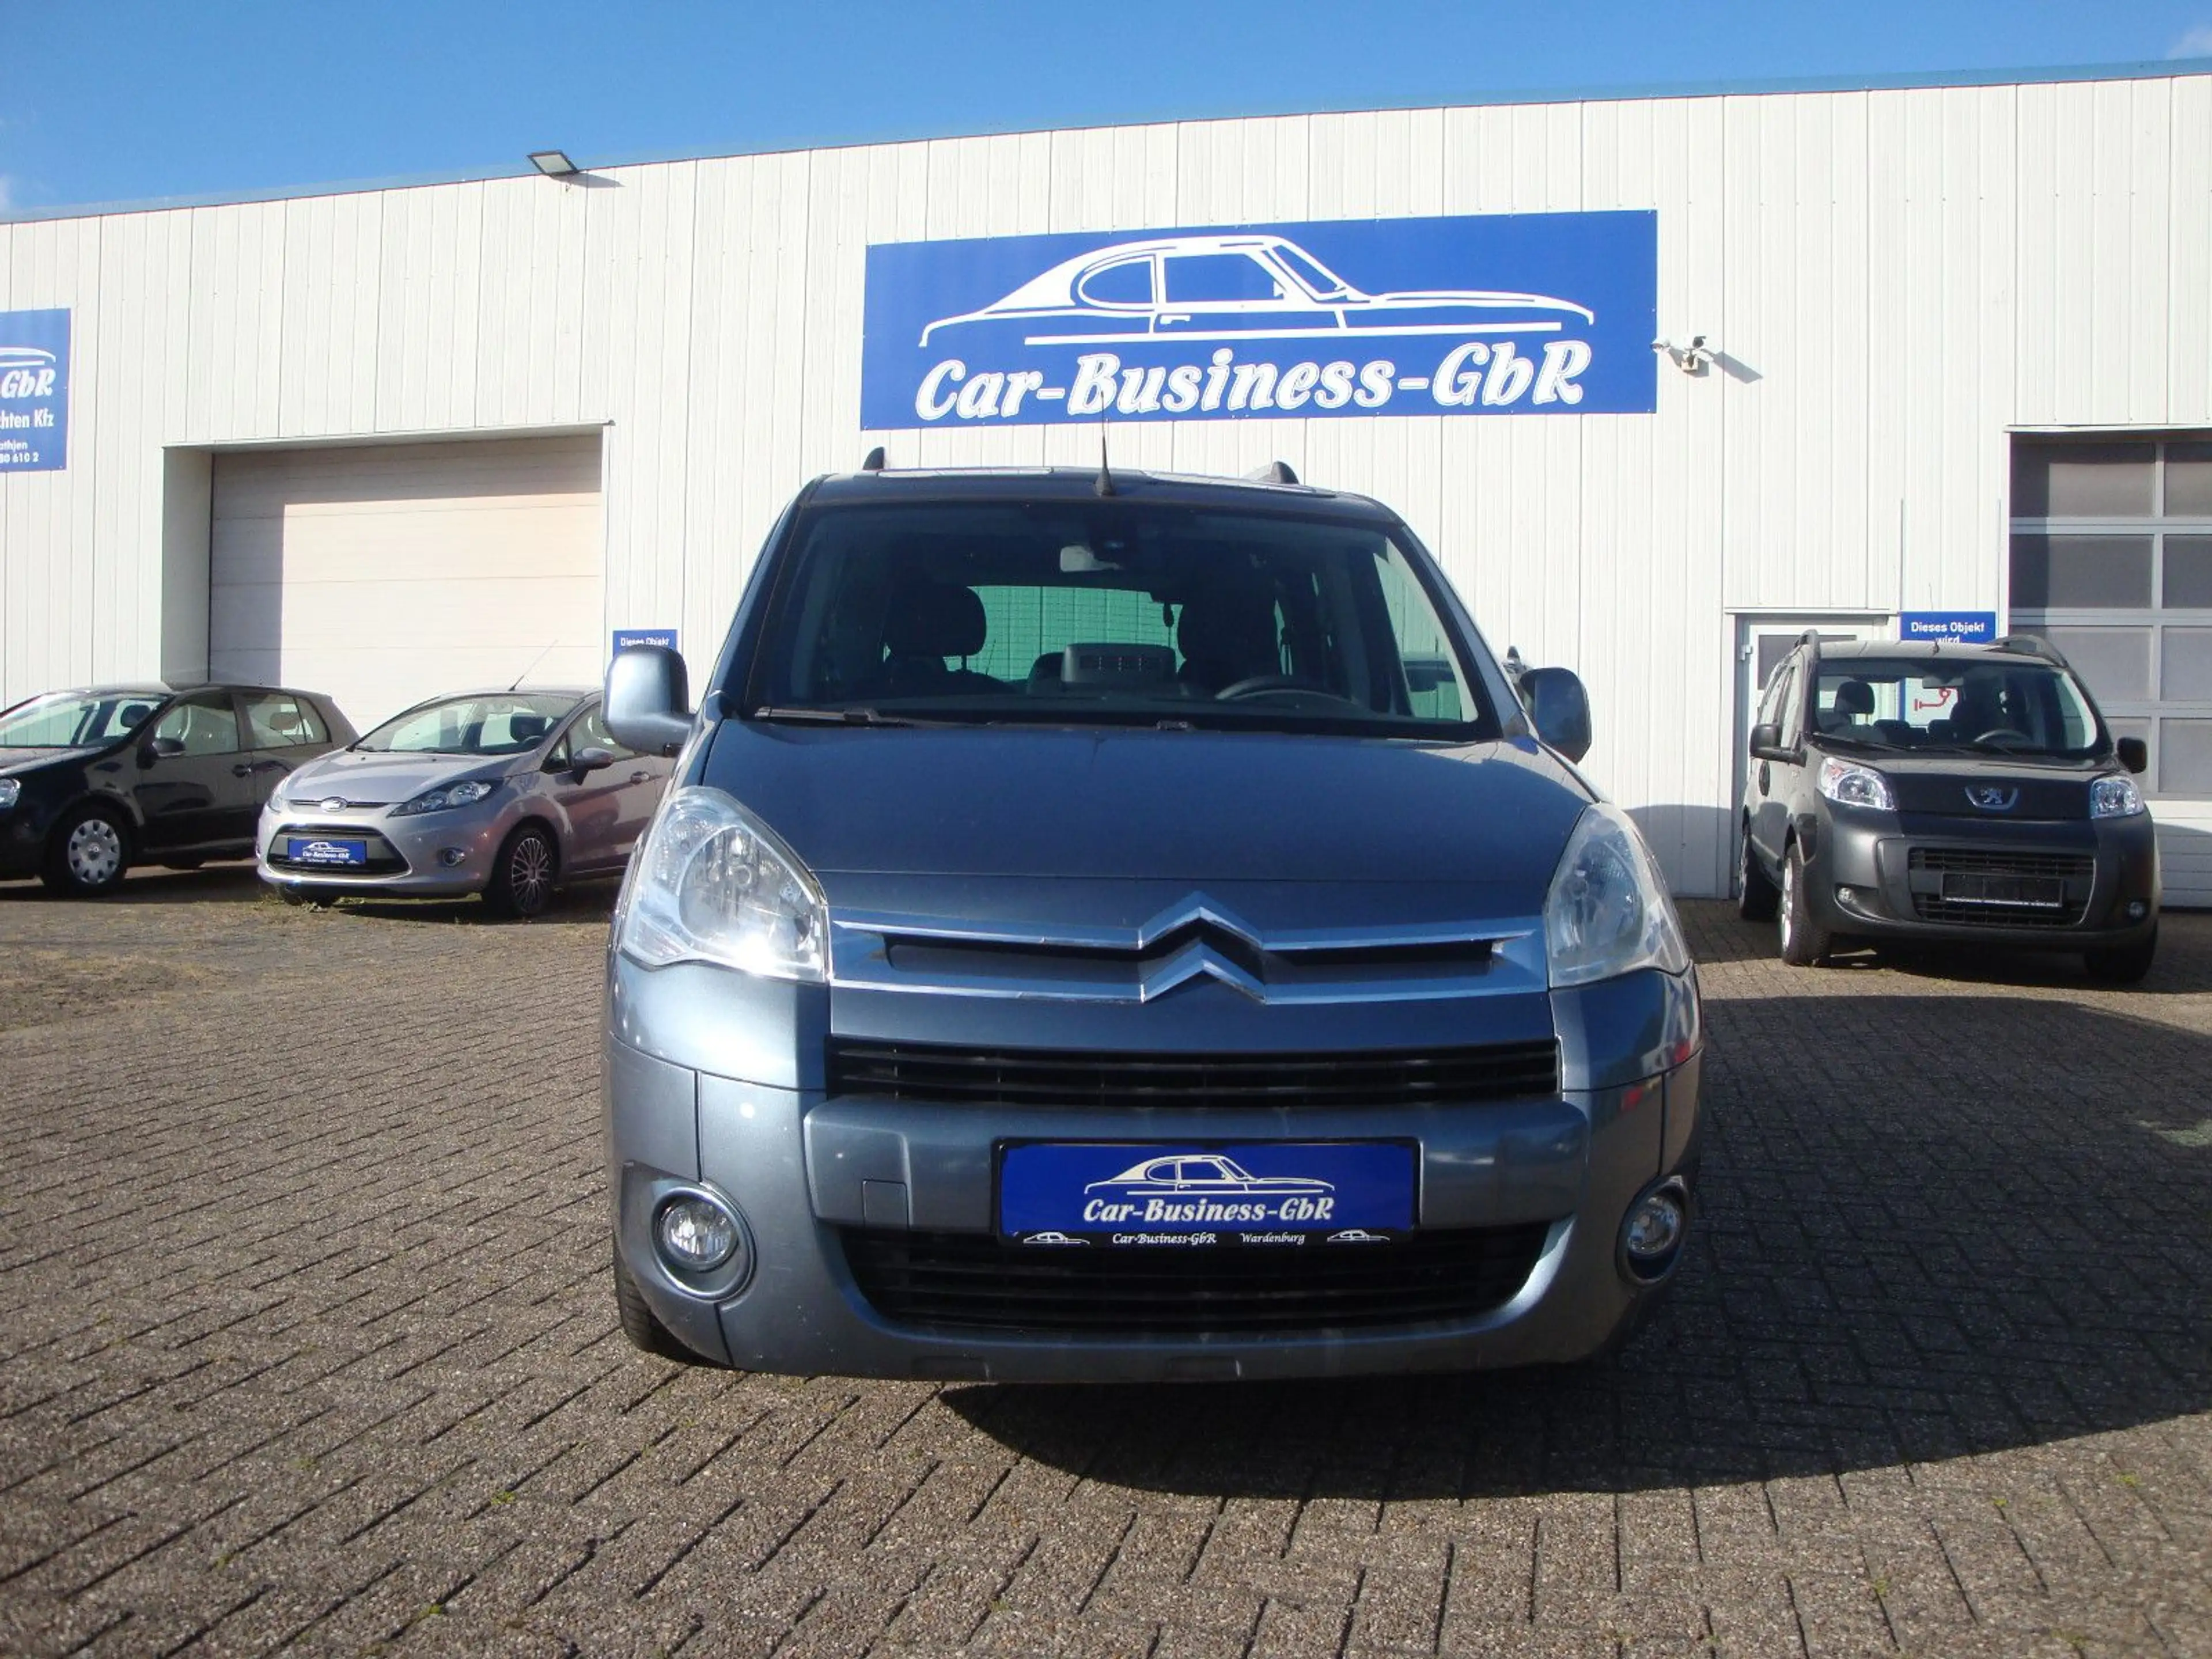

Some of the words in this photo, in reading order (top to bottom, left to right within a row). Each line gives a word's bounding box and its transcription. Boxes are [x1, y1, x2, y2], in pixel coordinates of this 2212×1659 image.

[915, 340, 1592, 421] Car-Business-GbR
[34, 407, 54, 428] Kfz
[32, 452, 39, 463] 2
[1911, 622, 1948, 632] Dieses
[1949, 622, 1985, 634] Objekt
[1083, 1196, 1335, 1222] Car-Business-GbR
[1112, 1231, 1217, 1245] Car-Business-GbR
[1240, 1232, 1306, 1245] Wardenburg
